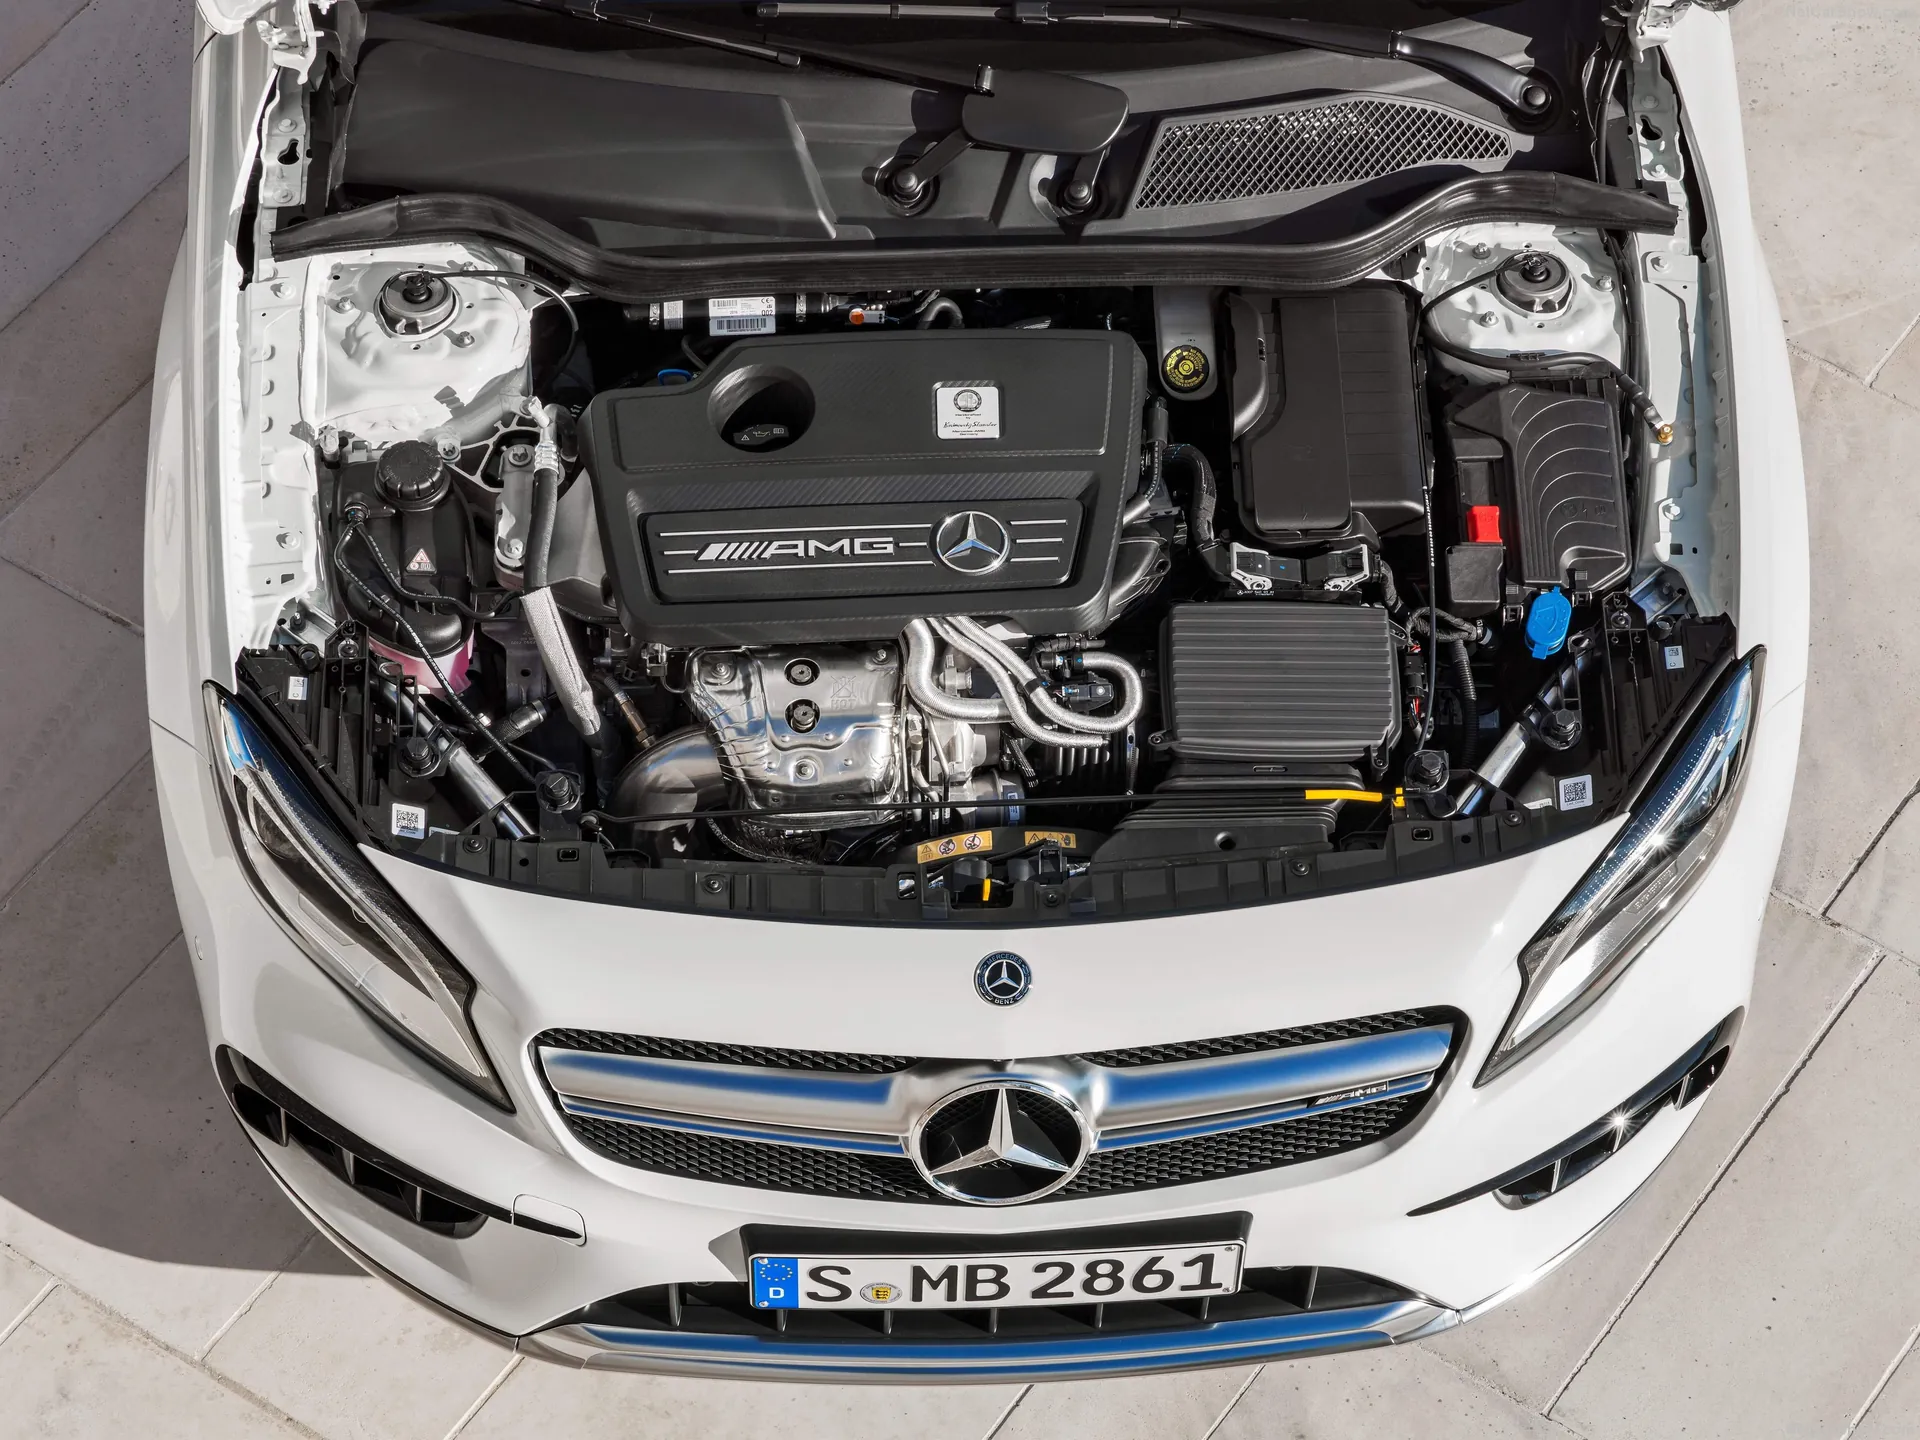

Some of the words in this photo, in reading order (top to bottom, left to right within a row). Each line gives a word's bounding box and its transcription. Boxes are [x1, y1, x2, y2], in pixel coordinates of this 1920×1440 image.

[761, 537, 894, 560] AMG
[986, 953, 1023, 965] MERCEDES
[994, 997, 1015, 1005] BENZ
[1340, 1084, 1386, 1098] AMG
[807, 1265, 852, 1303] S
[911, 1264, 1011, 1302] MB
[1031, 1253, 1223, 1299] 2861
[769, 1287, 785, 1299] D
